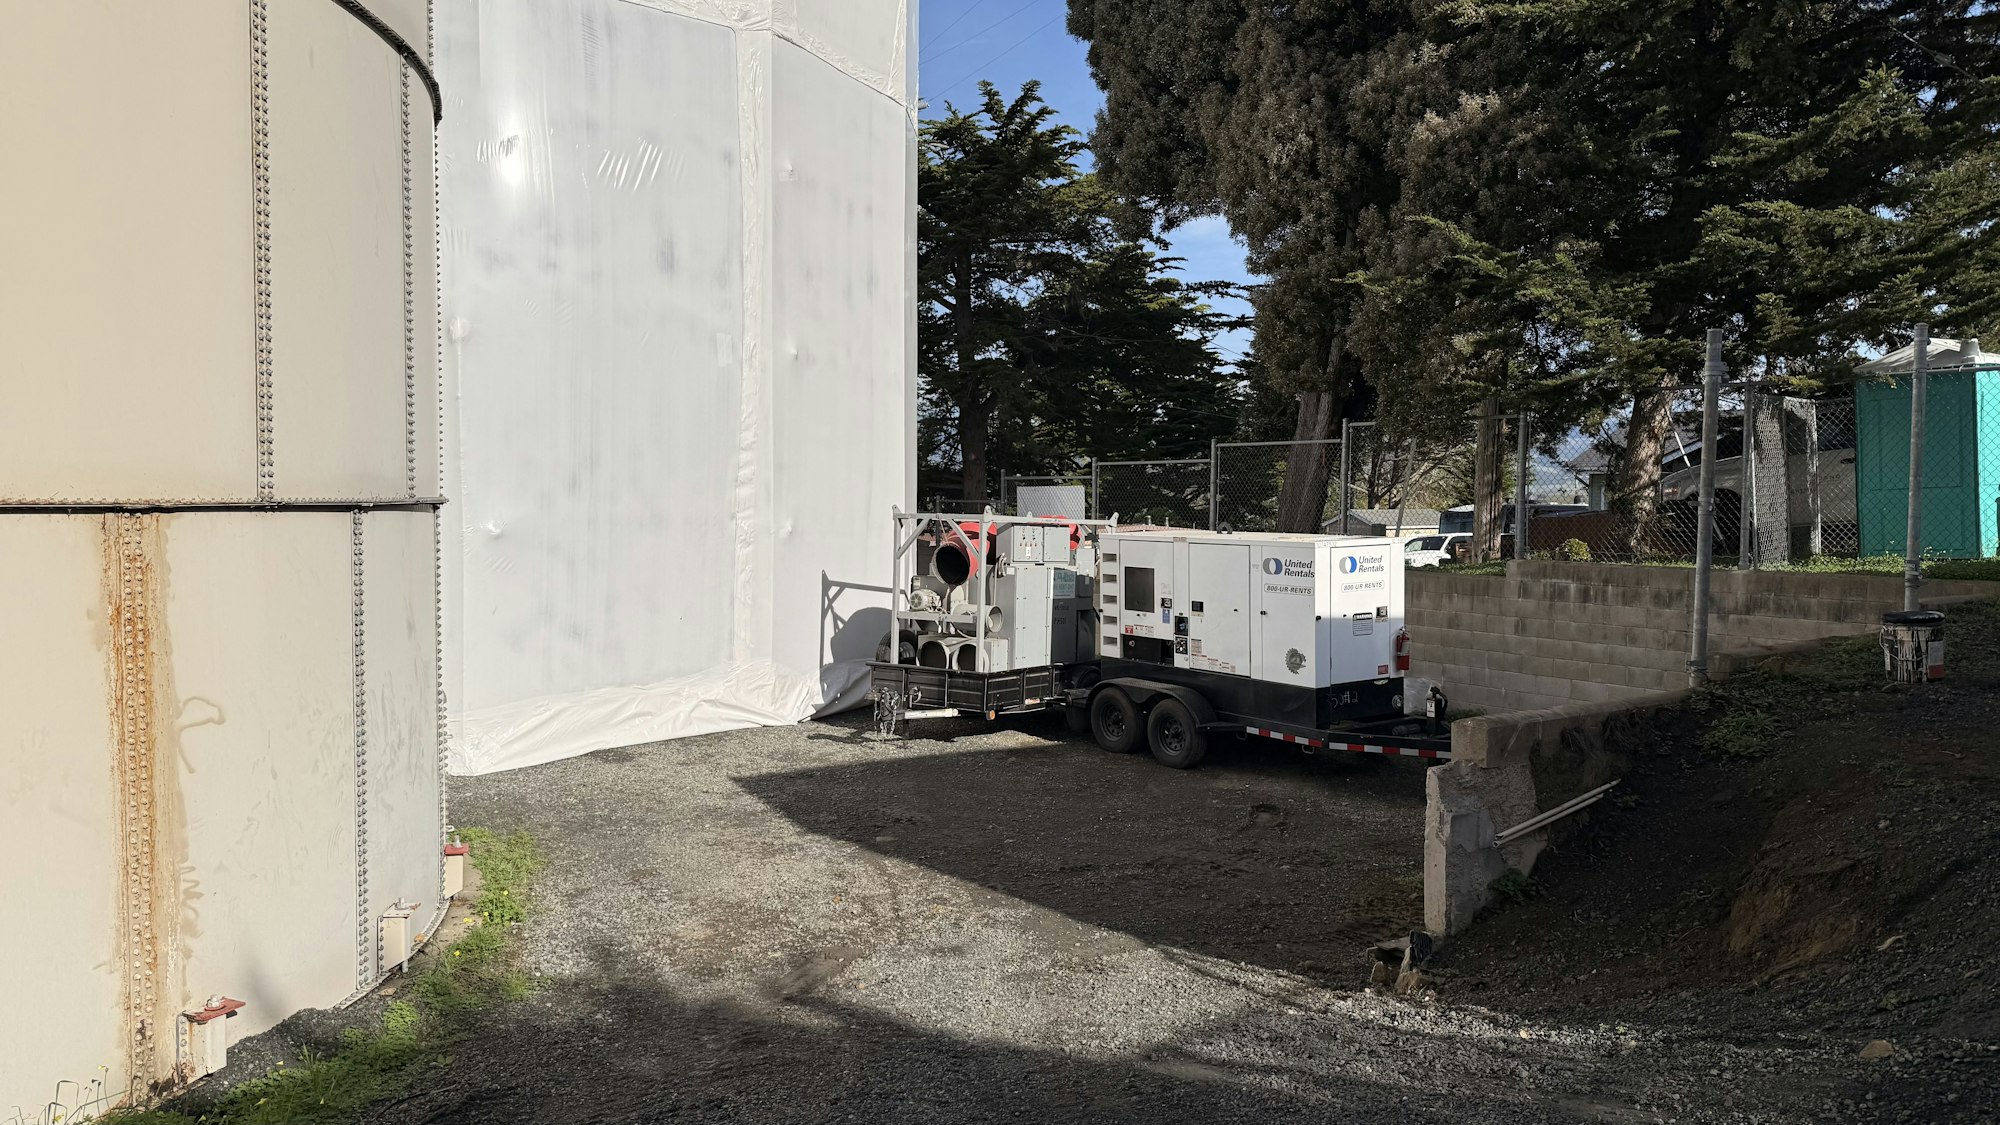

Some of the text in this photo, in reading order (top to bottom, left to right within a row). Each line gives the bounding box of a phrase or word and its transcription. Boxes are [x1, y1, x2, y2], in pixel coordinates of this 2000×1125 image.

[1284, 559, 1312, 569] United
[1358, 555, 1383, 565] United
[1284, 568, 1315, 578] Rentals
[1358, 564, 1384, 573] Rentals
[1266, 585, 1312, 595] 800-UR-RENTS
